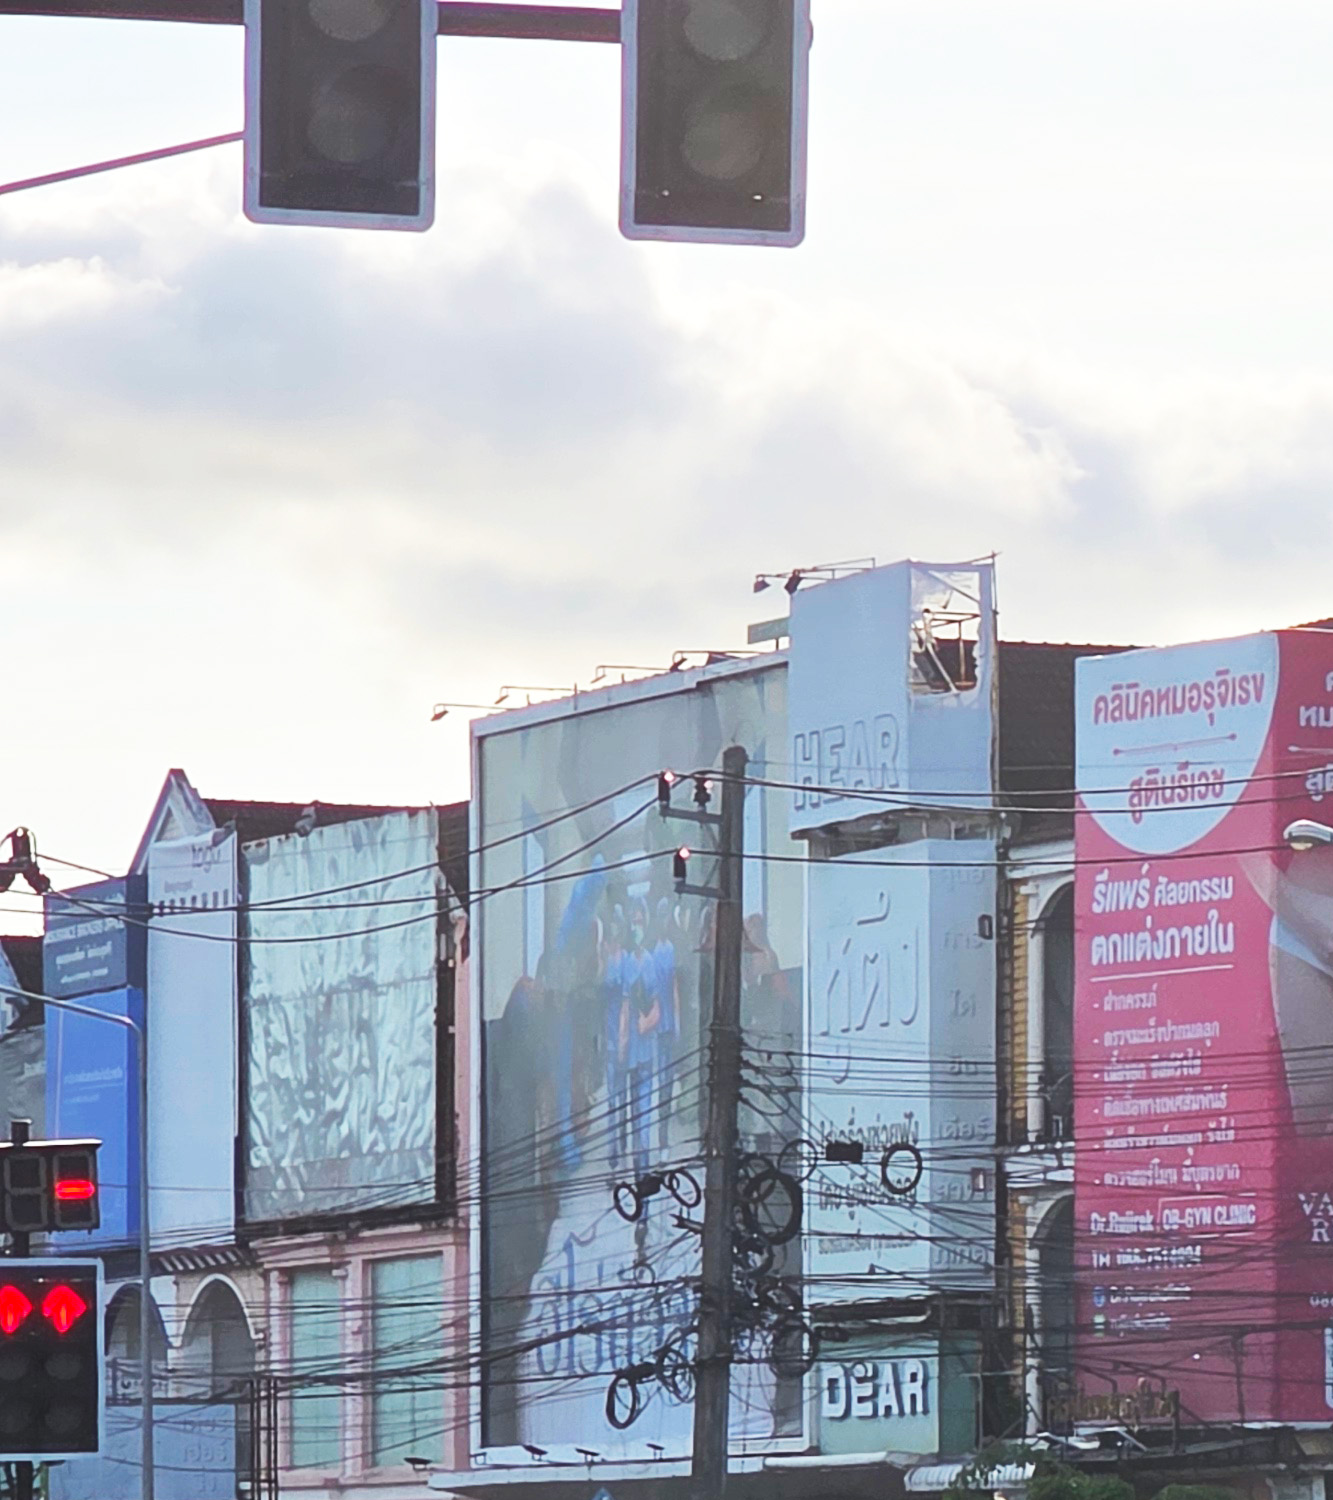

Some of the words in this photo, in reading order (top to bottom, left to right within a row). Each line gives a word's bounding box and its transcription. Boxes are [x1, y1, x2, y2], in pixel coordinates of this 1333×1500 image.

[794, 713, 900, 811] HEAR
[1154, 876, 1233, 907] ศัลยกรรม
[1091, 909, 1234, 966] ตกแต่งภายใน
[822, 1360, 929, 1420] DEAR
